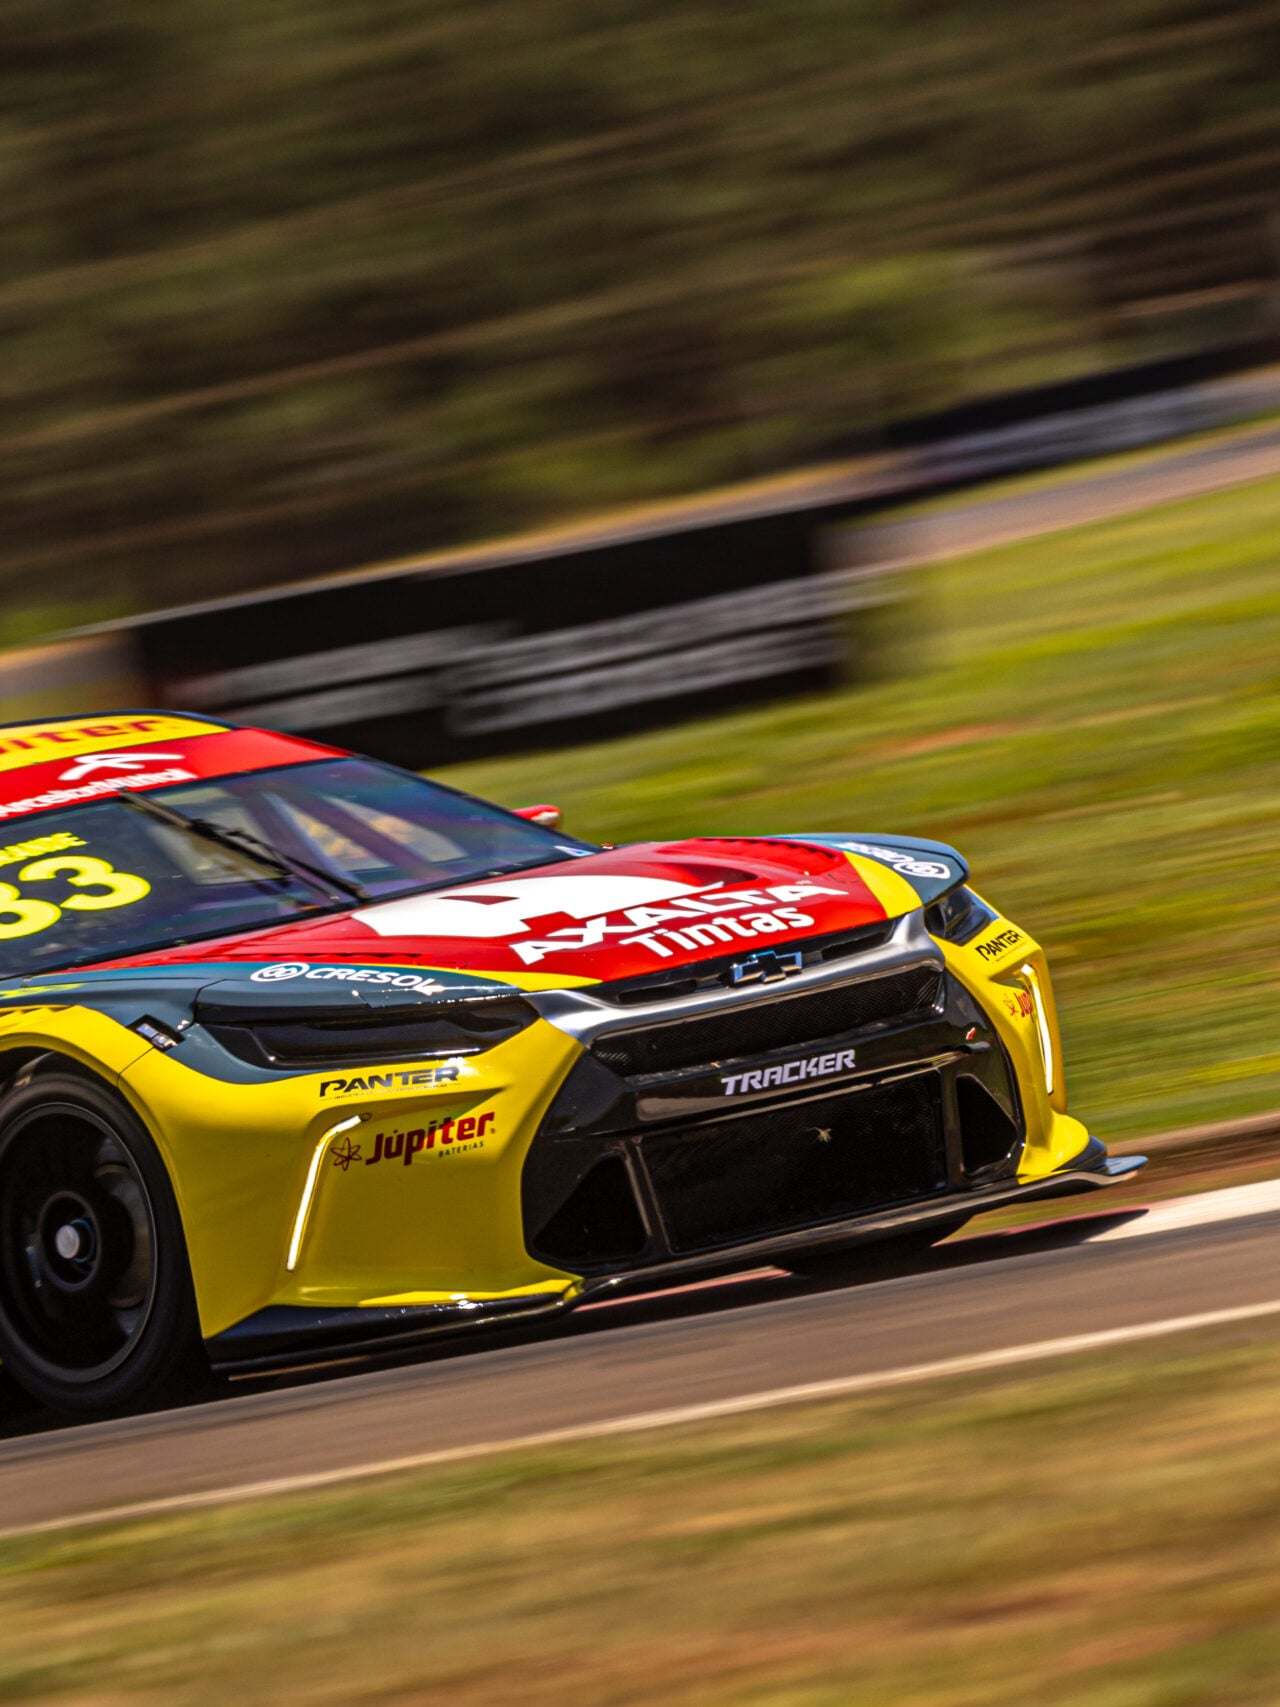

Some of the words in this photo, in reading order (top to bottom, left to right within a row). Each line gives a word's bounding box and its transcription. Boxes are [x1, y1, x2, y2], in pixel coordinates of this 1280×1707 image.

[508, 884, 849, 965] AXALTA
[618, 907, 815, 958] Tintas
[975, 929, 1024, 961] PANTER
[319, 1066, 459, 1098] PANTER
[721, 1049, 856, 1096] TRACKER
[365, 1111, 496, 1166] Júpiter
[438, 1140, 484, 1158] BATERIAS
